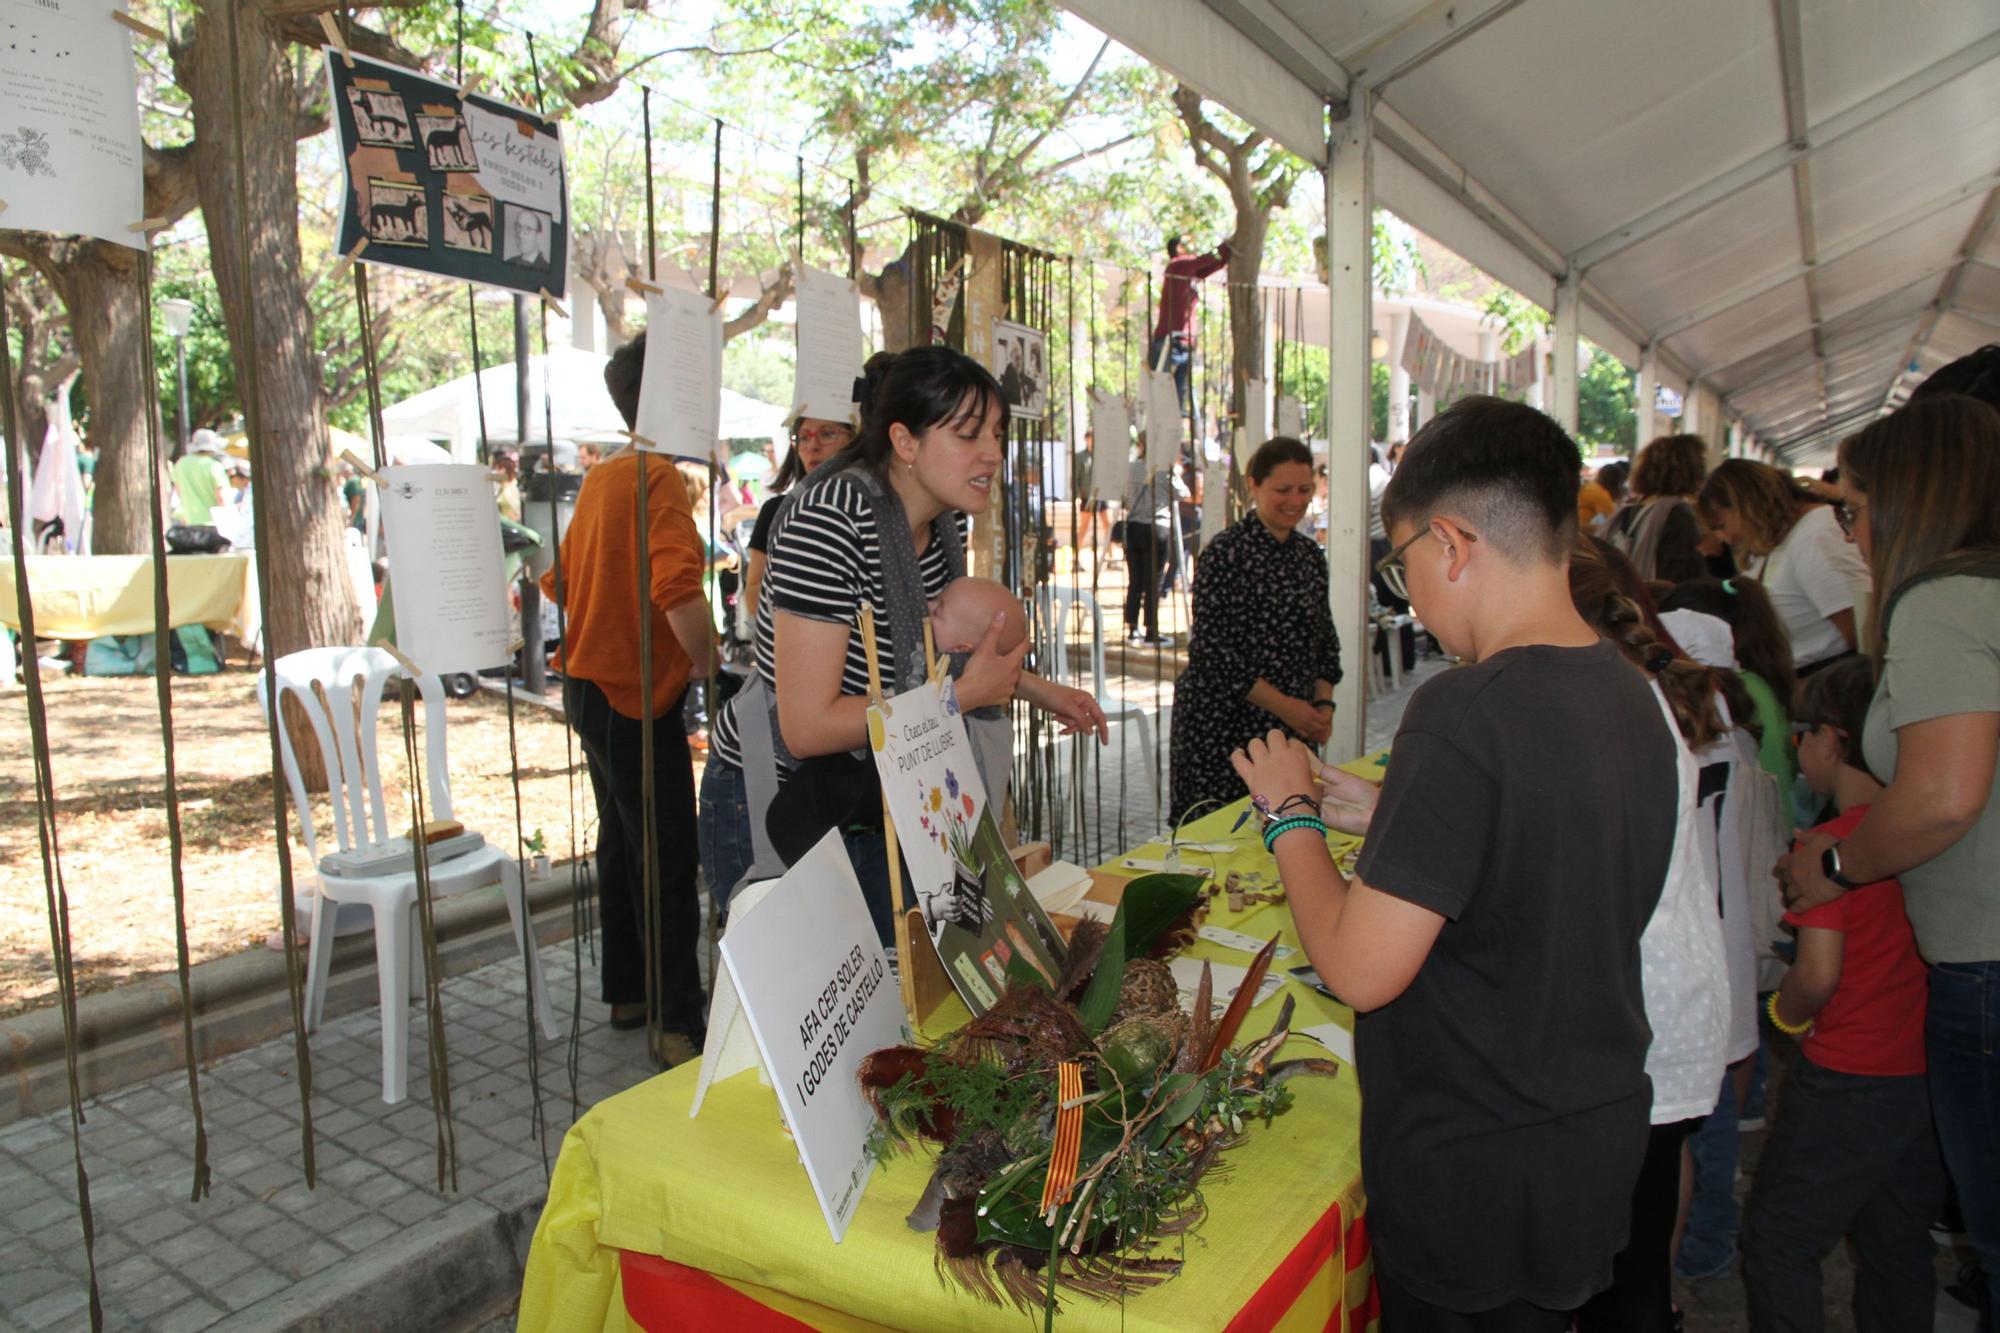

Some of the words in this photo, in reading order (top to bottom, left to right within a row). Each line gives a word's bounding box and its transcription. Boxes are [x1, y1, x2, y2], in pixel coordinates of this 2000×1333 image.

[470, 114, 502, 151] Les
[505, 132, 560, 176] bestioles
[897, 747, 921, 775] PUNT
[920, 741, 934, 762] DE
[931, 730, 956, 756] LLIBRE
[903, 724, 923, 742] Crea
[800, 1009, 822, 1050] AFA
[817, 979, 838, 1021] CEIP
[836, 944, 865, 992] SOLER
[796, 1082, 807, 1107] I
[803, 1034, 838, 1096] GODES
[833, 1013, 850, 1046] DE
[845, 953, 884, 1026] CASTELLÓ
